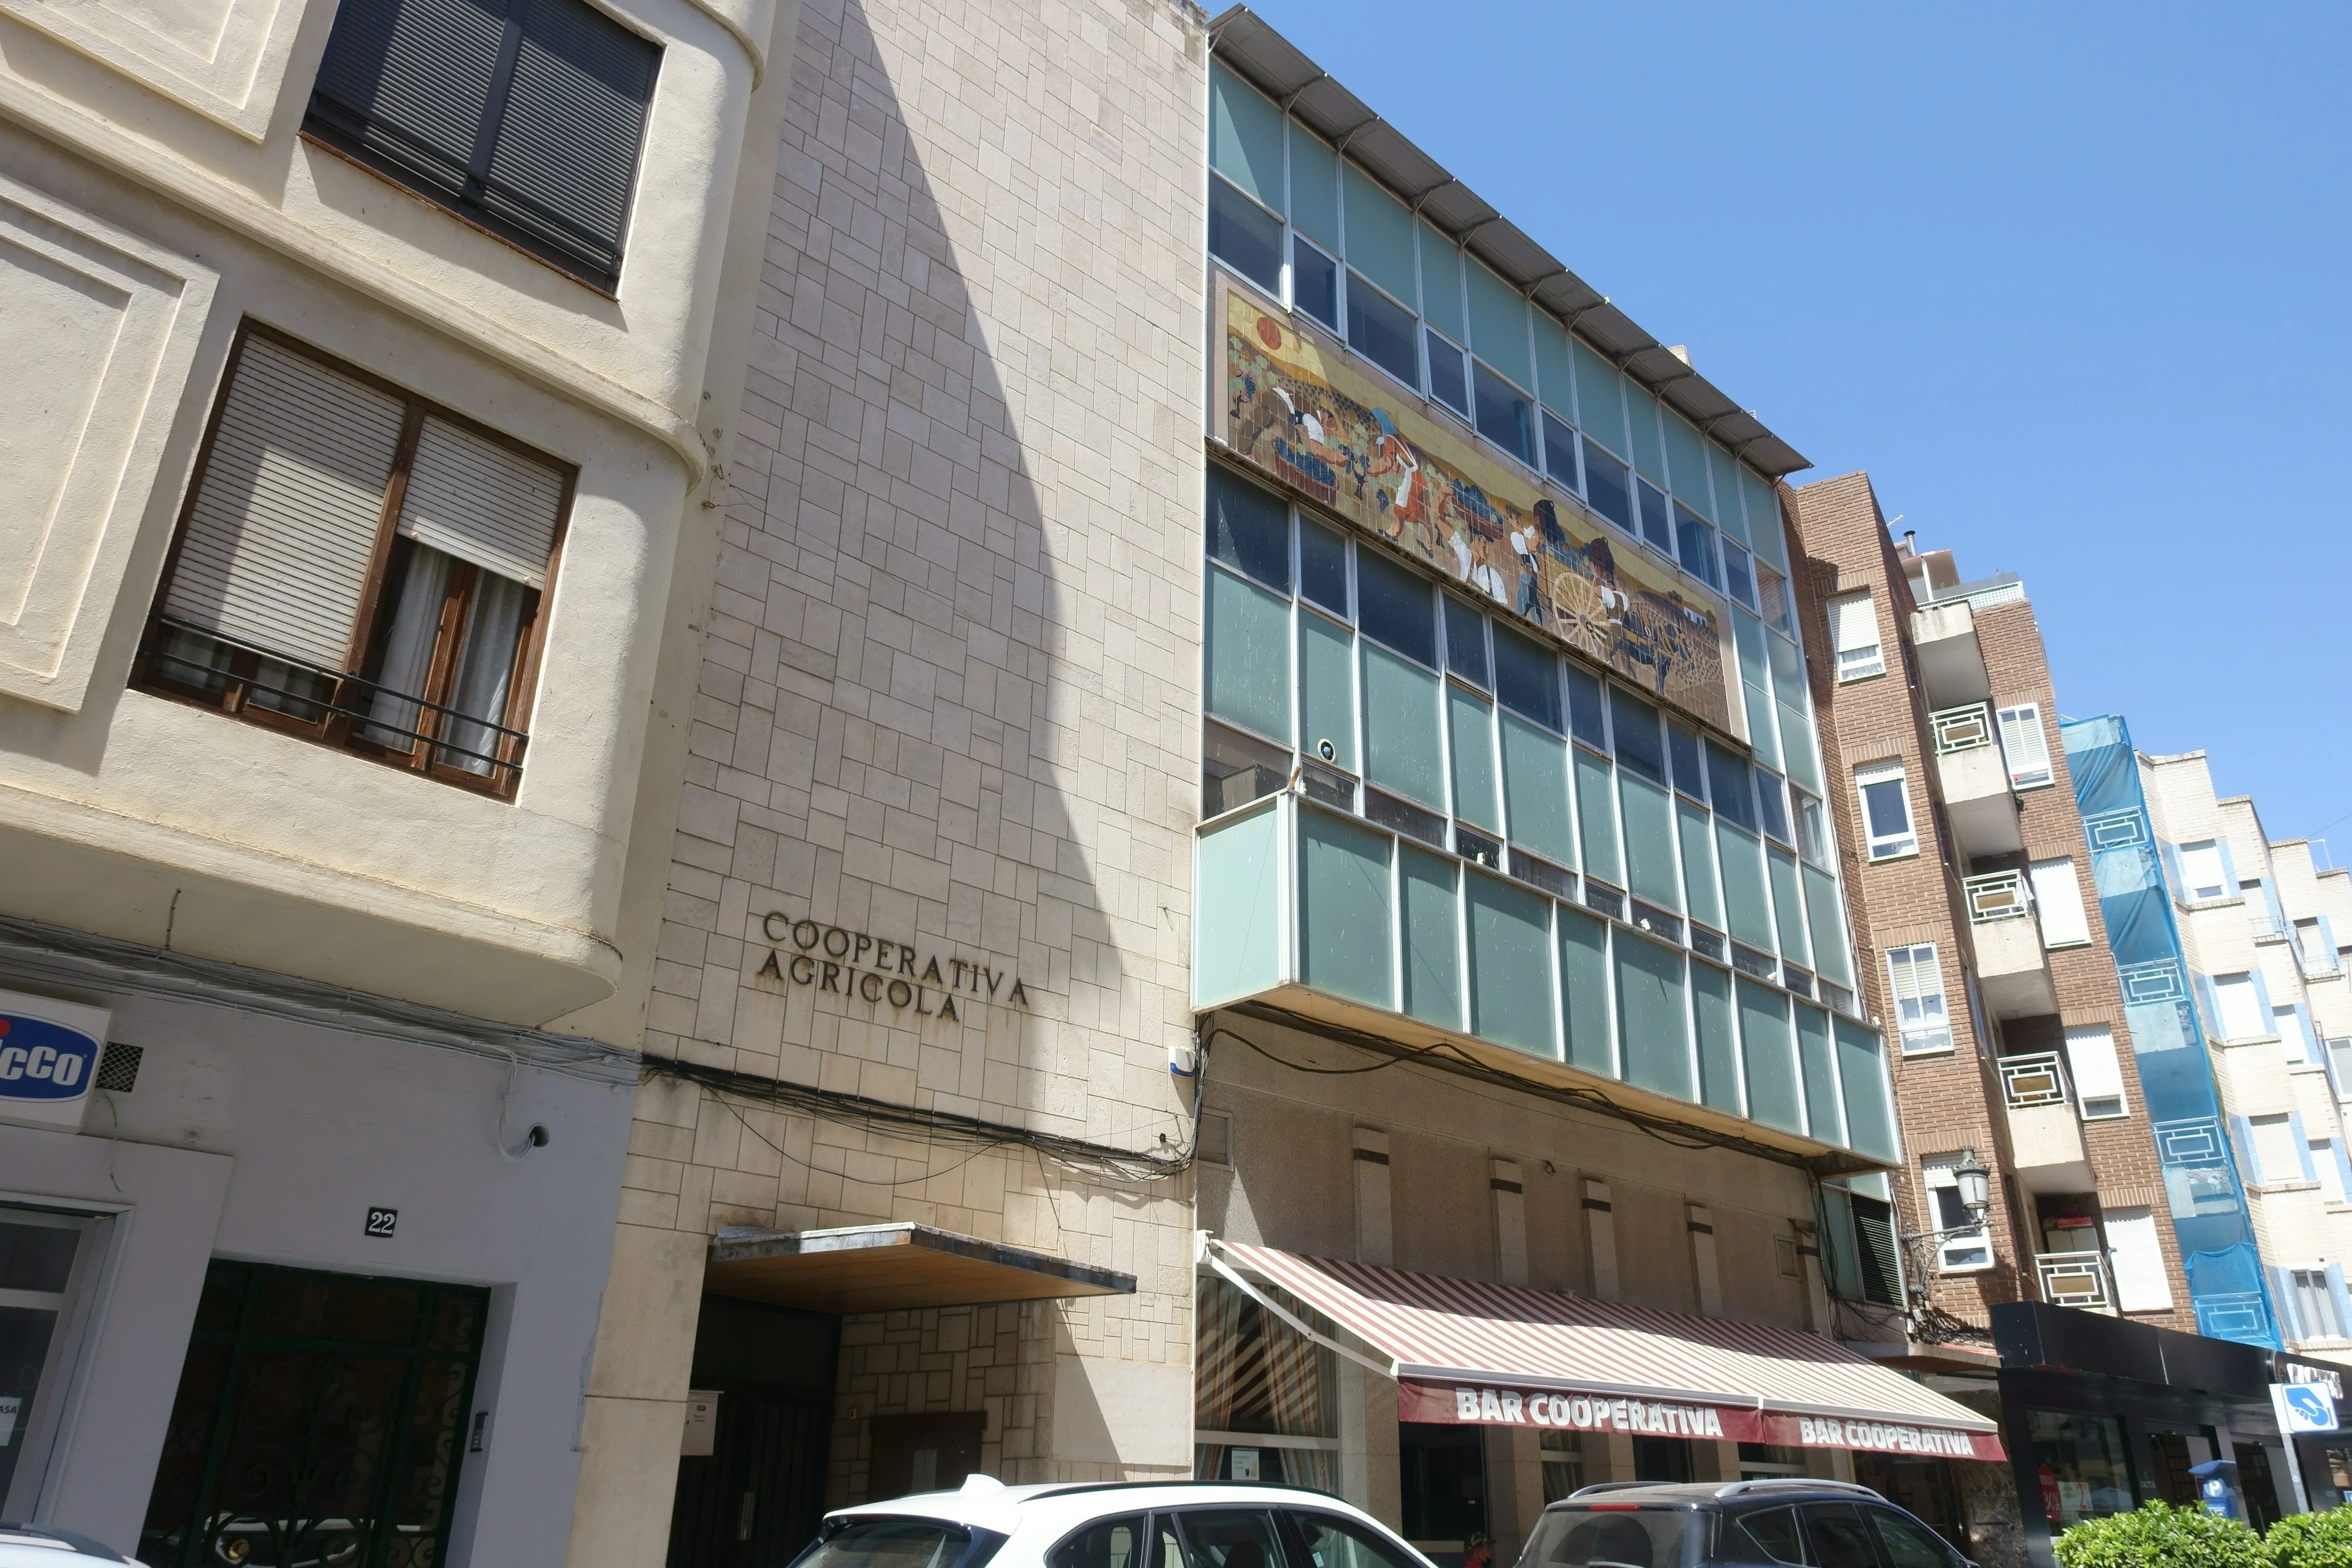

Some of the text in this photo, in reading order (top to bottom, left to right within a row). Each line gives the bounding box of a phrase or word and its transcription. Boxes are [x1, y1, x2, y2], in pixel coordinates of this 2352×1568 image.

[763, 911, 1028, 1006] COOPERATIVA
[758, 949, 960, 1023] AGRICOLA
[369, 1211, 395, 1234] 22
[1456, 1387, 1724, 1437] BAR COOPERATIVA
[1799, 1417, 1975, 1455] BAR COOPERATIVA
[2043, 1491, 2061, 1511] 30%
[2209, 1480, 2220, 1496] P
